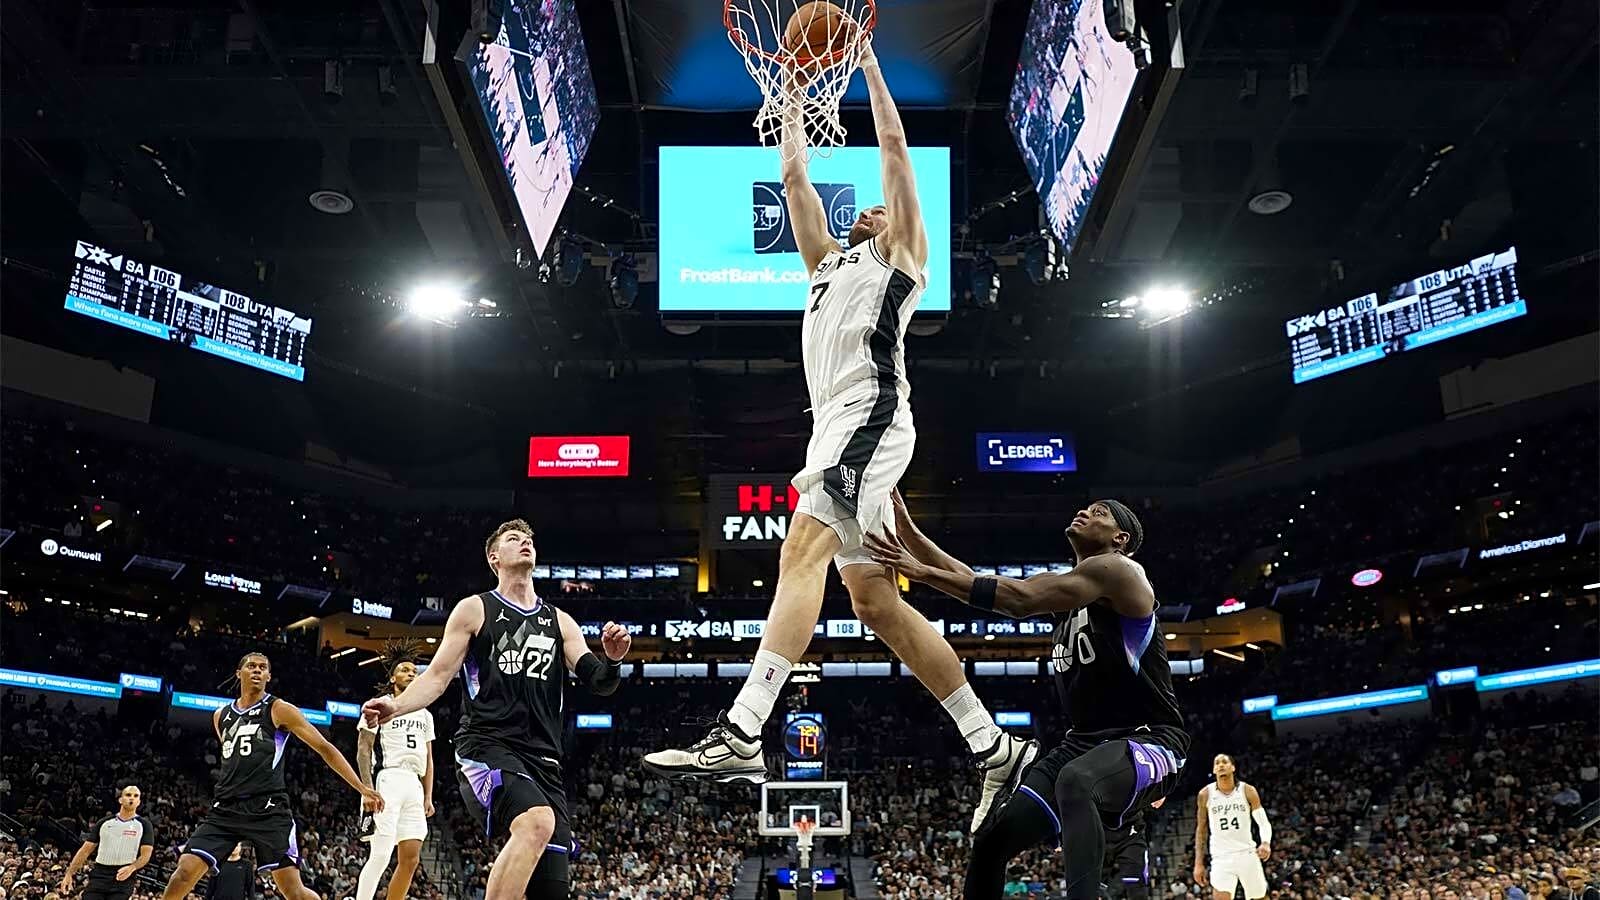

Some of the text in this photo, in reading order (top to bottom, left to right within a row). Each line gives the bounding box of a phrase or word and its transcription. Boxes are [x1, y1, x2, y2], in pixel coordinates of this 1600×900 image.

[125, 259, 145, 276] SA
[1445, 263, 1472, 282] UTA
[152, 268, 176, 287] 106
[680, 268, 811, 284] FrostBank.co
[1419, 273, 1441, 290] 108
[224, 292, 245, 310] 108
[810, 282, 830, 313] 7
[1352, 296, 1372, 313] 106
[248, 301, 273, 318] UTA
[1326, 305, 1345, 321] SA
[999, 445, 1053, 459] LEDGER
[538, 459, 619, 469] Here Everything's Better
[1521, 533, 1566, 550] Diamond
[60, 546, 101, 562] Ownwell
[205, 571, 231, 585] LONE
[235, 577, 261, 590] STAR
[711, 621, 733, 637] SA
[742, 623, 762, 635] 106
[836, 623, 854, 634] 108
[950, 623, 966, 634] PF
[987, 623, 1015, 634] FG%
[1037, 623, 1053, 634] TO
[526, 650, 552, 681] 22
[392, 719, 426, 733] SPURS
[239, 736, 252, 756] 5
[406, 734, 416, 749] 5
[800, 736, 817, 755] 14
[1212, 803, 1246, 815] SPURS
[1219, 817, 1240, 831] 24
